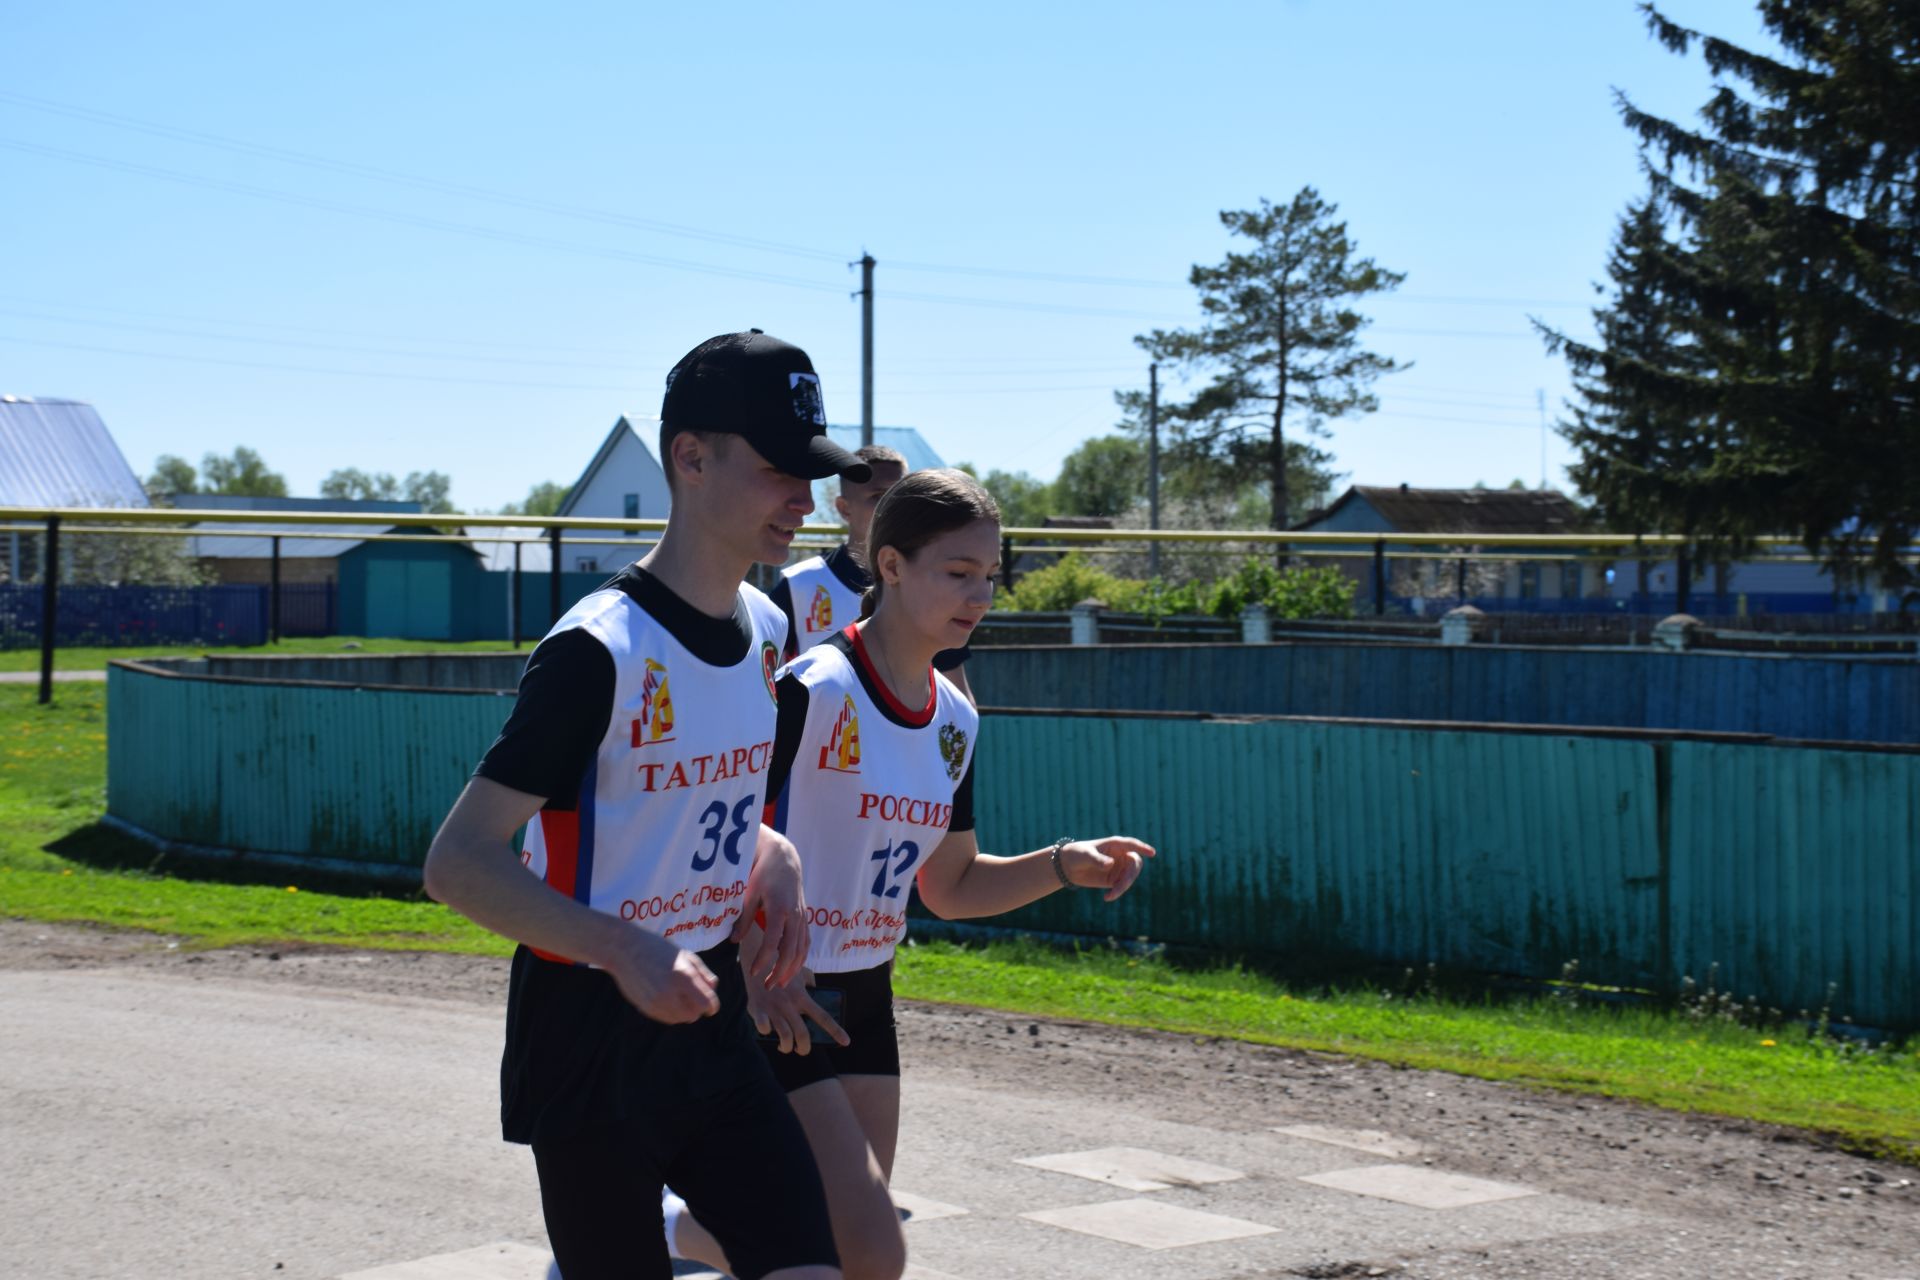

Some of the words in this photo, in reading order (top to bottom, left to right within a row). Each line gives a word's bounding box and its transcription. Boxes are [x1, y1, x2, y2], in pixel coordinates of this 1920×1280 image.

[637, 741, 774, 793] ТАТАРСТ
[856, 792, 953, 829] РОССИЯ
[870, 837, 920, 899] 12
